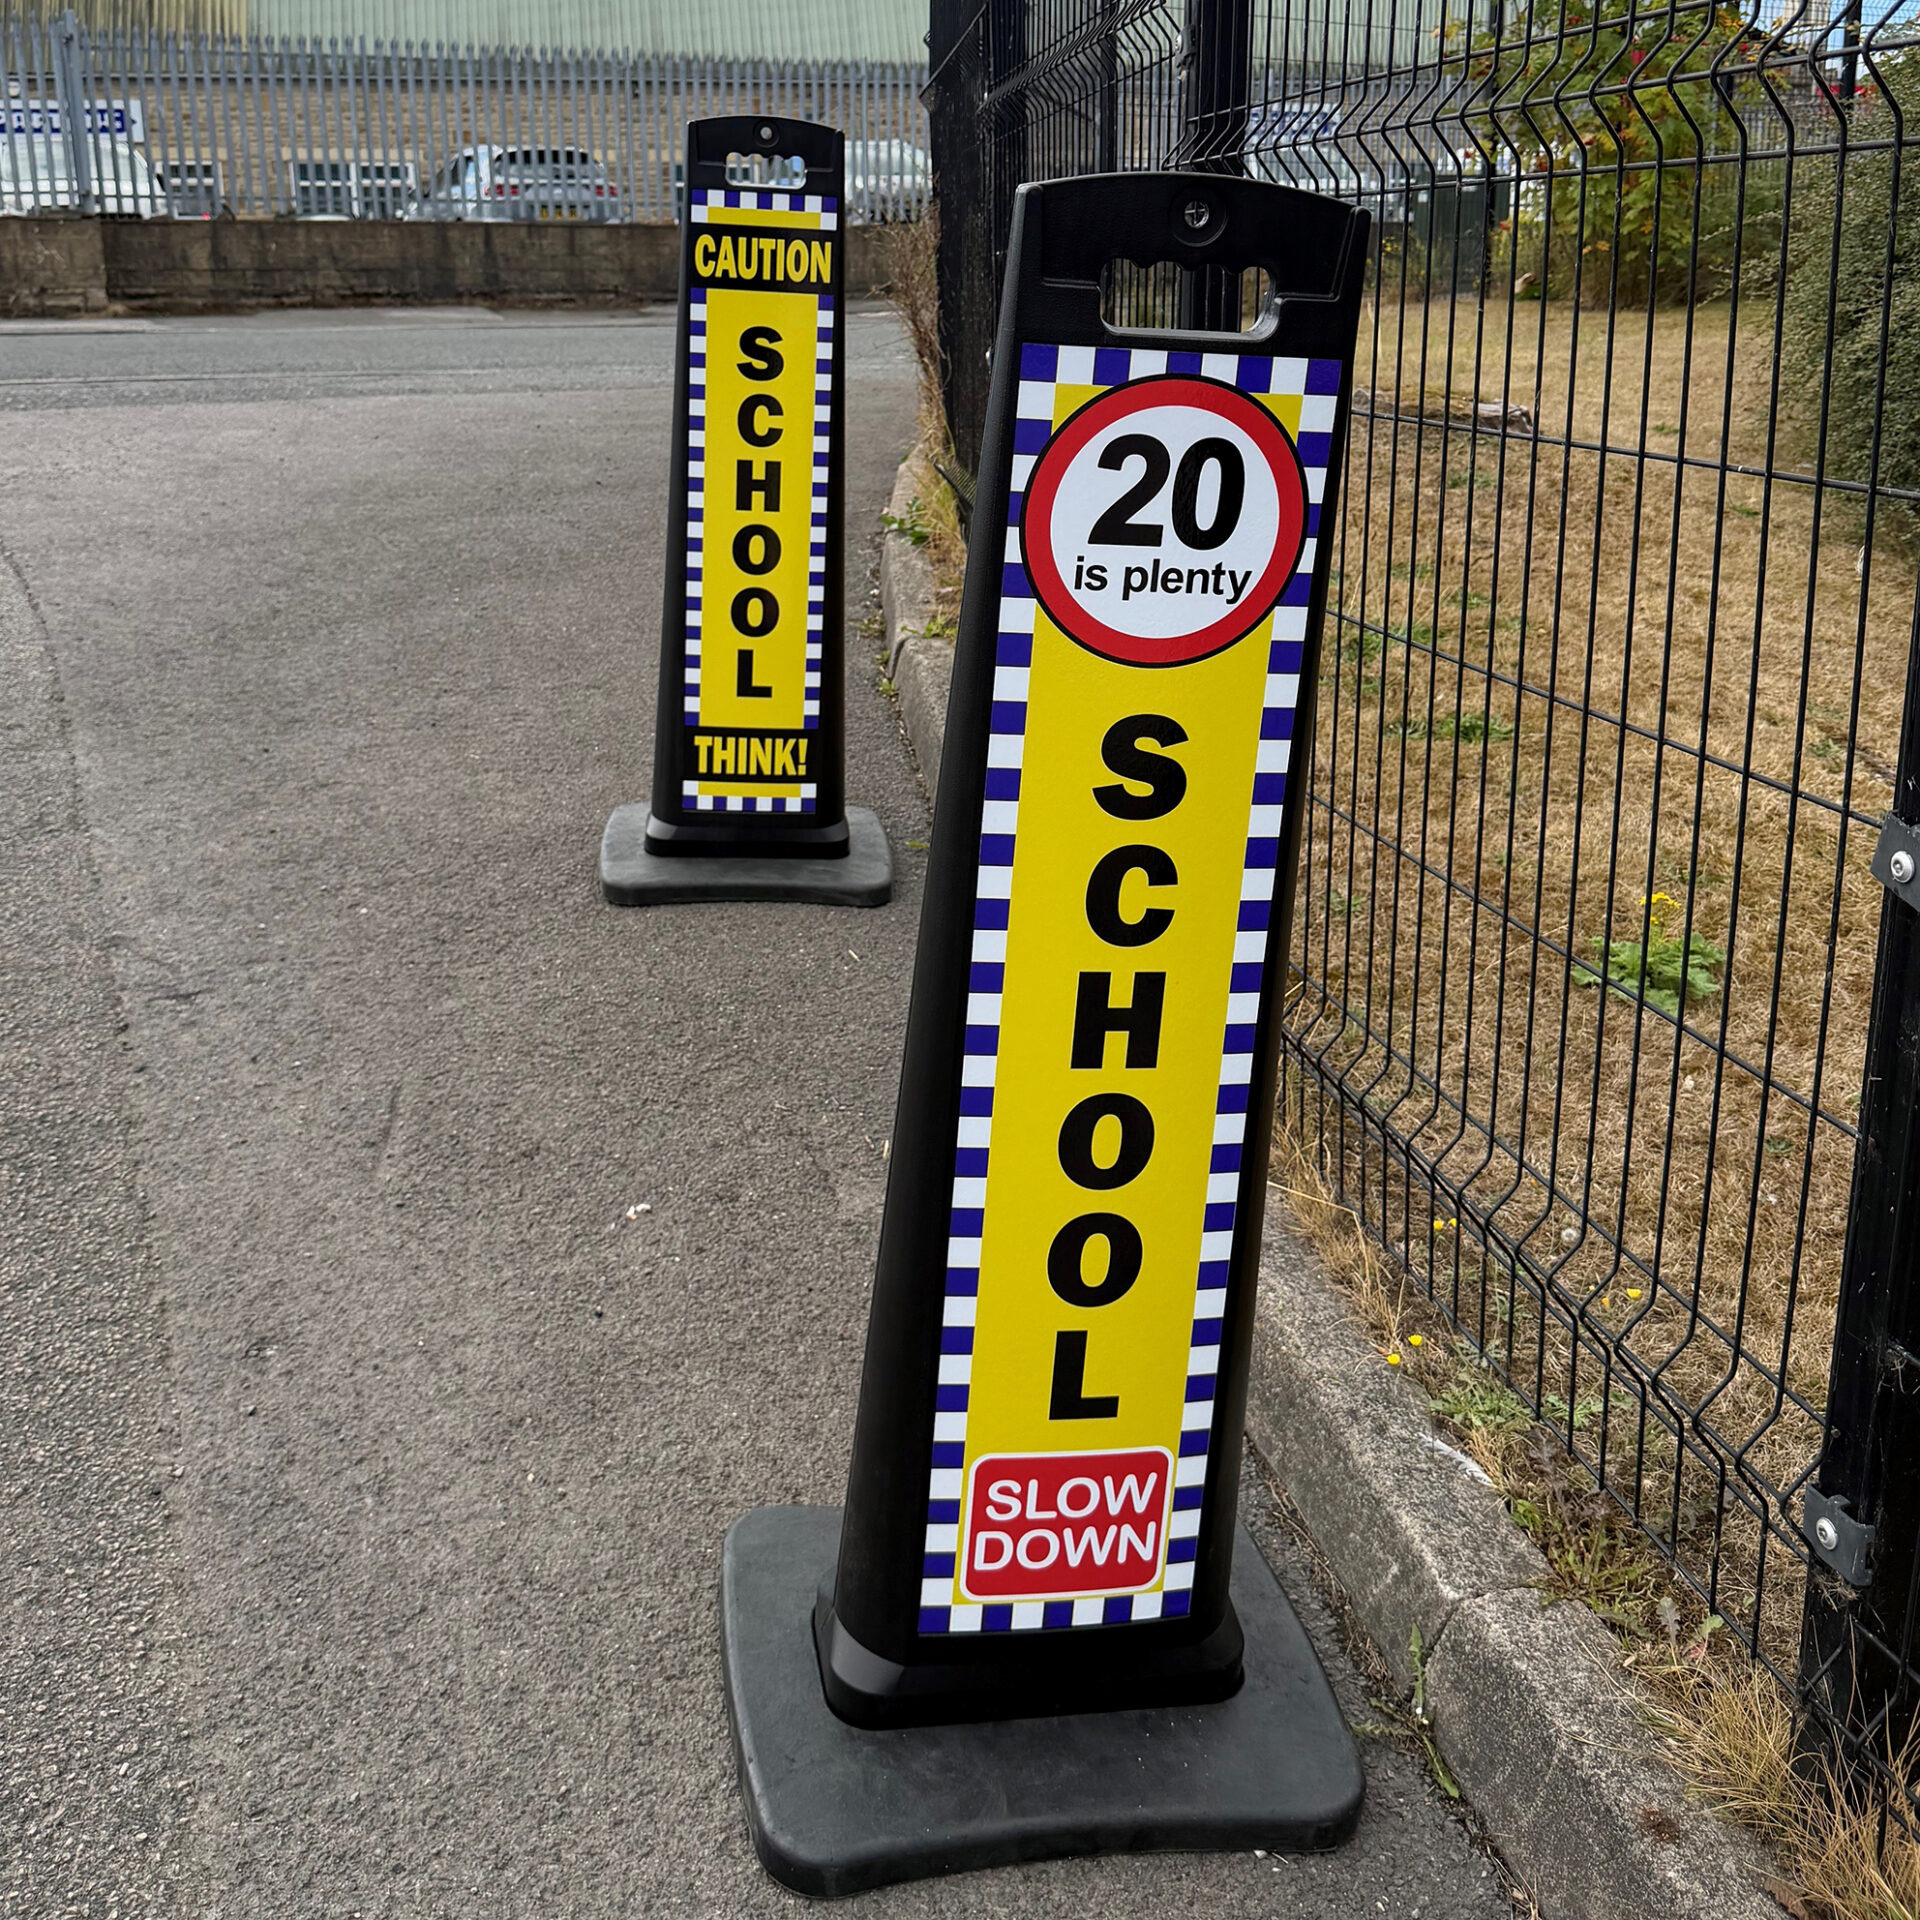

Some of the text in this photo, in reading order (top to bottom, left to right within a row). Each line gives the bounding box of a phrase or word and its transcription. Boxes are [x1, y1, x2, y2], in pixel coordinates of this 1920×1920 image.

[694, 233, 832, 284] CAUTION
[731, 325, 785, 698] SCHOOL
[1087, 433, 1245, 551] 20
[1074, 555, 1253, 605] is plenty
[693, 735, 808, 776] THINK!
[1049, 713, 1189, 1421] SCHOOL
[985, 1471, 1158, 1521] SLOW
[973, 1521, 1157, 1571] DOWN
